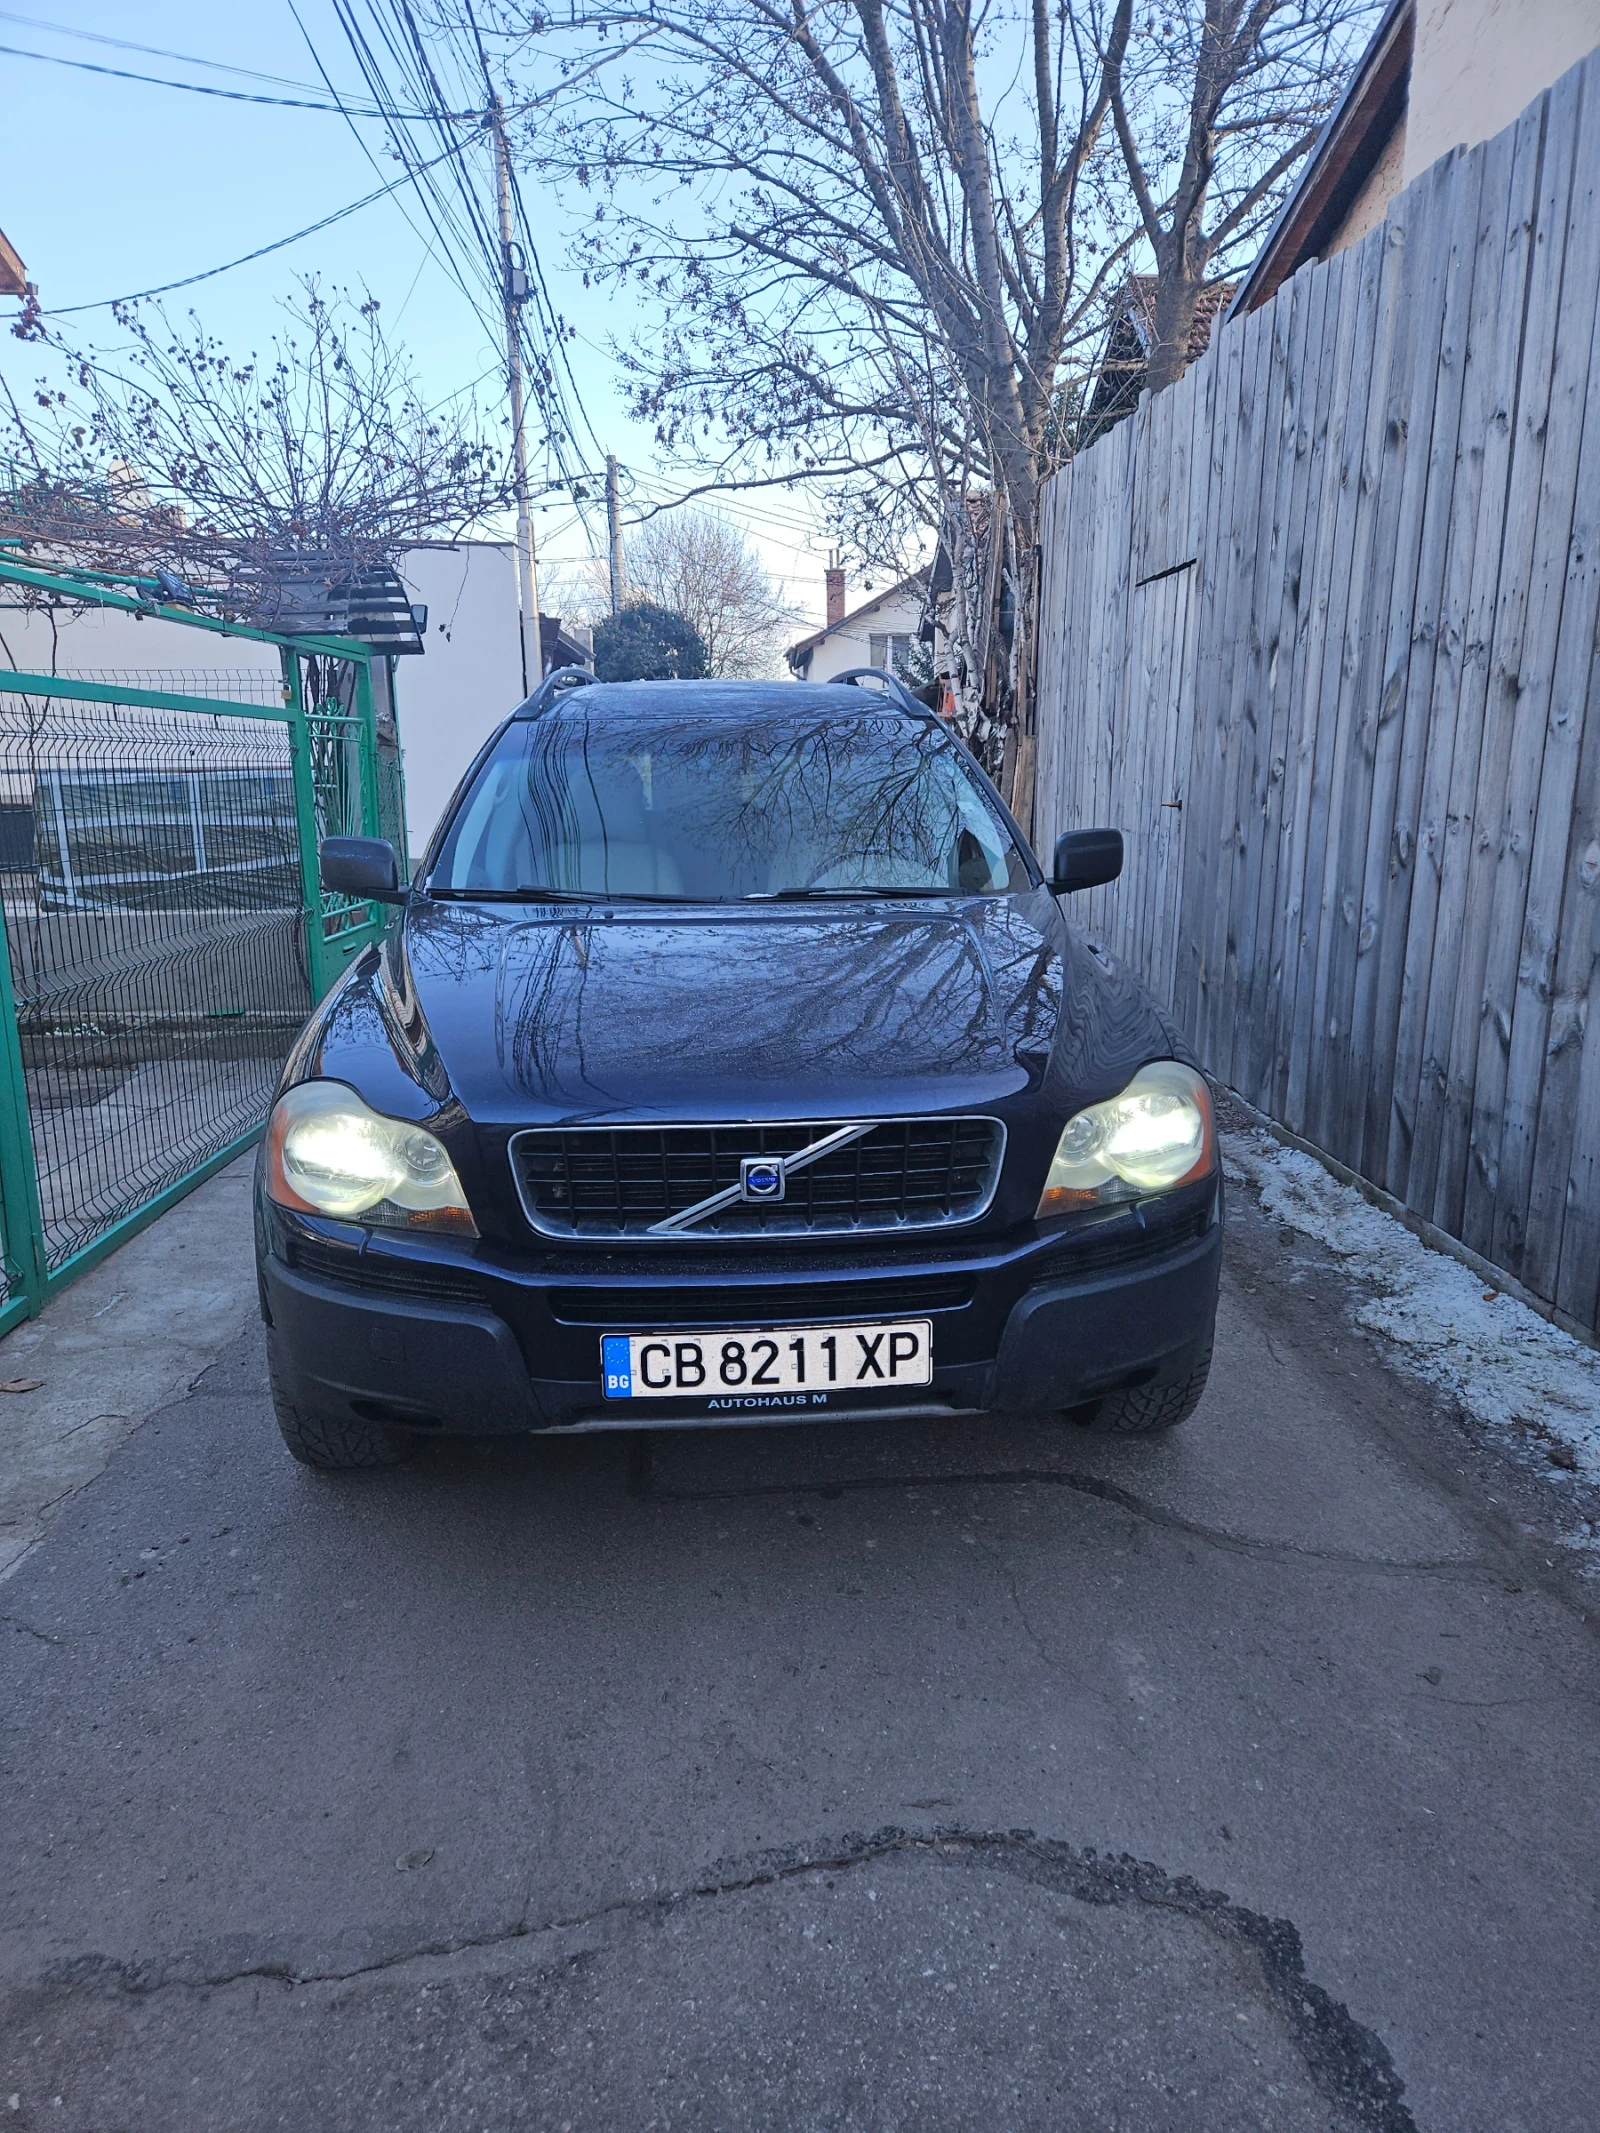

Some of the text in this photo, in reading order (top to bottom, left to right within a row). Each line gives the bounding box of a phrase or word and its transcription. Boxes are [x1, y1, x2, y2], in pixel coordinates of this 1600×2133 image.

[640, 1332, 919, 1389] CB 8211 XP
[608, 1375, 629, 1389] BG
[707, 1394, 827, 1409] AUTOHAUS M
